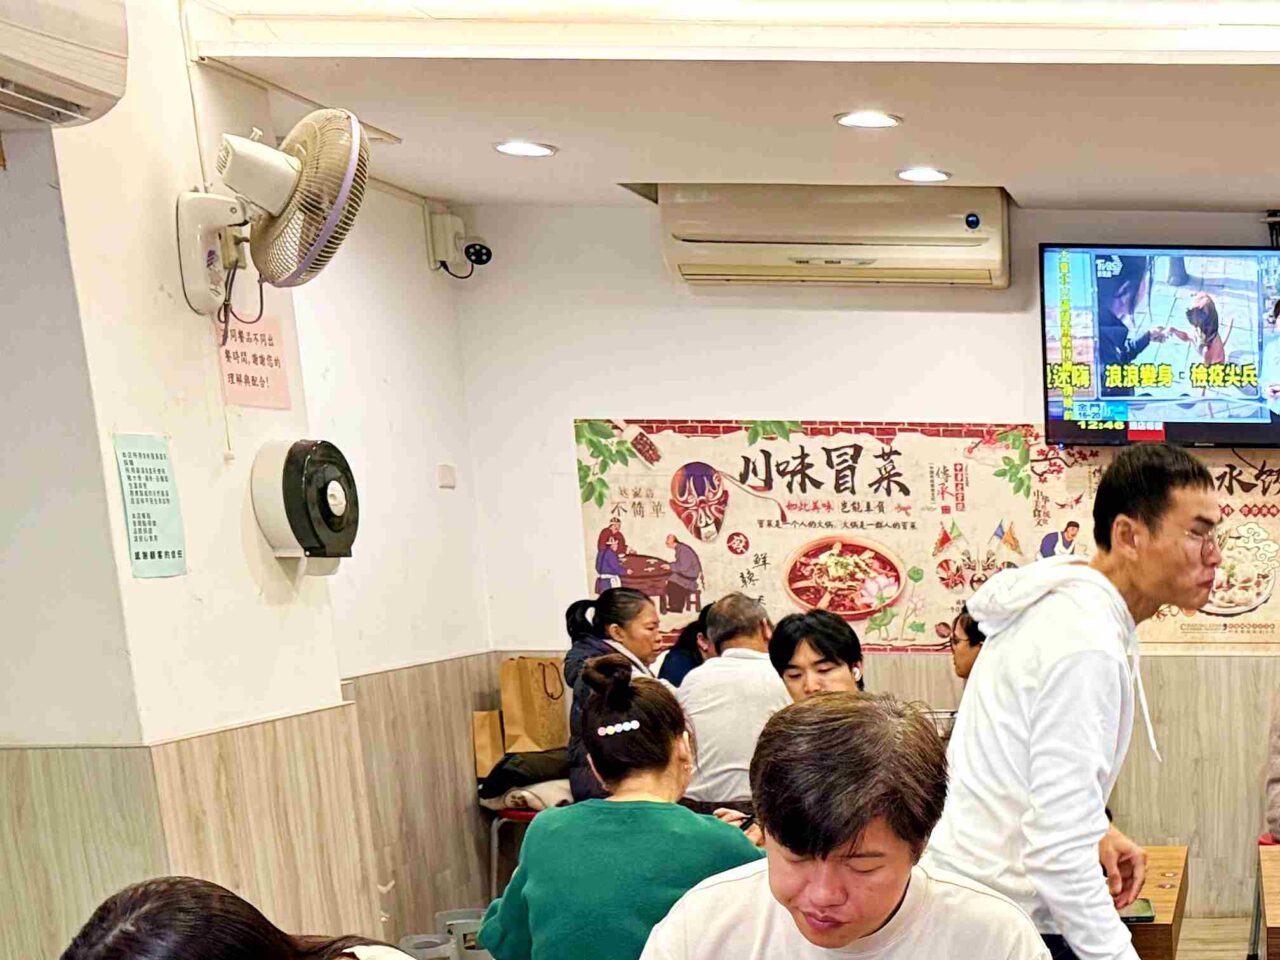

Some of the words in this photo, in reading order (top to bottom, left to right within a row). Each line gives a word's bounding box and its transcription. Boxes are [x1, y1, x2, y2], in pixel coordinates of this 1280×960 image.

[220, 328, 275, 347] 同餐品不同出
[1105, 363, 1174, 388] 浪浪變身
[1190, 363, 1258, 388] 檢疫尖兵
[1077, 420, 1125, 430] 12:46
[740, 443, 911, 497] 川味冒菜
[786, 500, 833, 513] 如此美味
